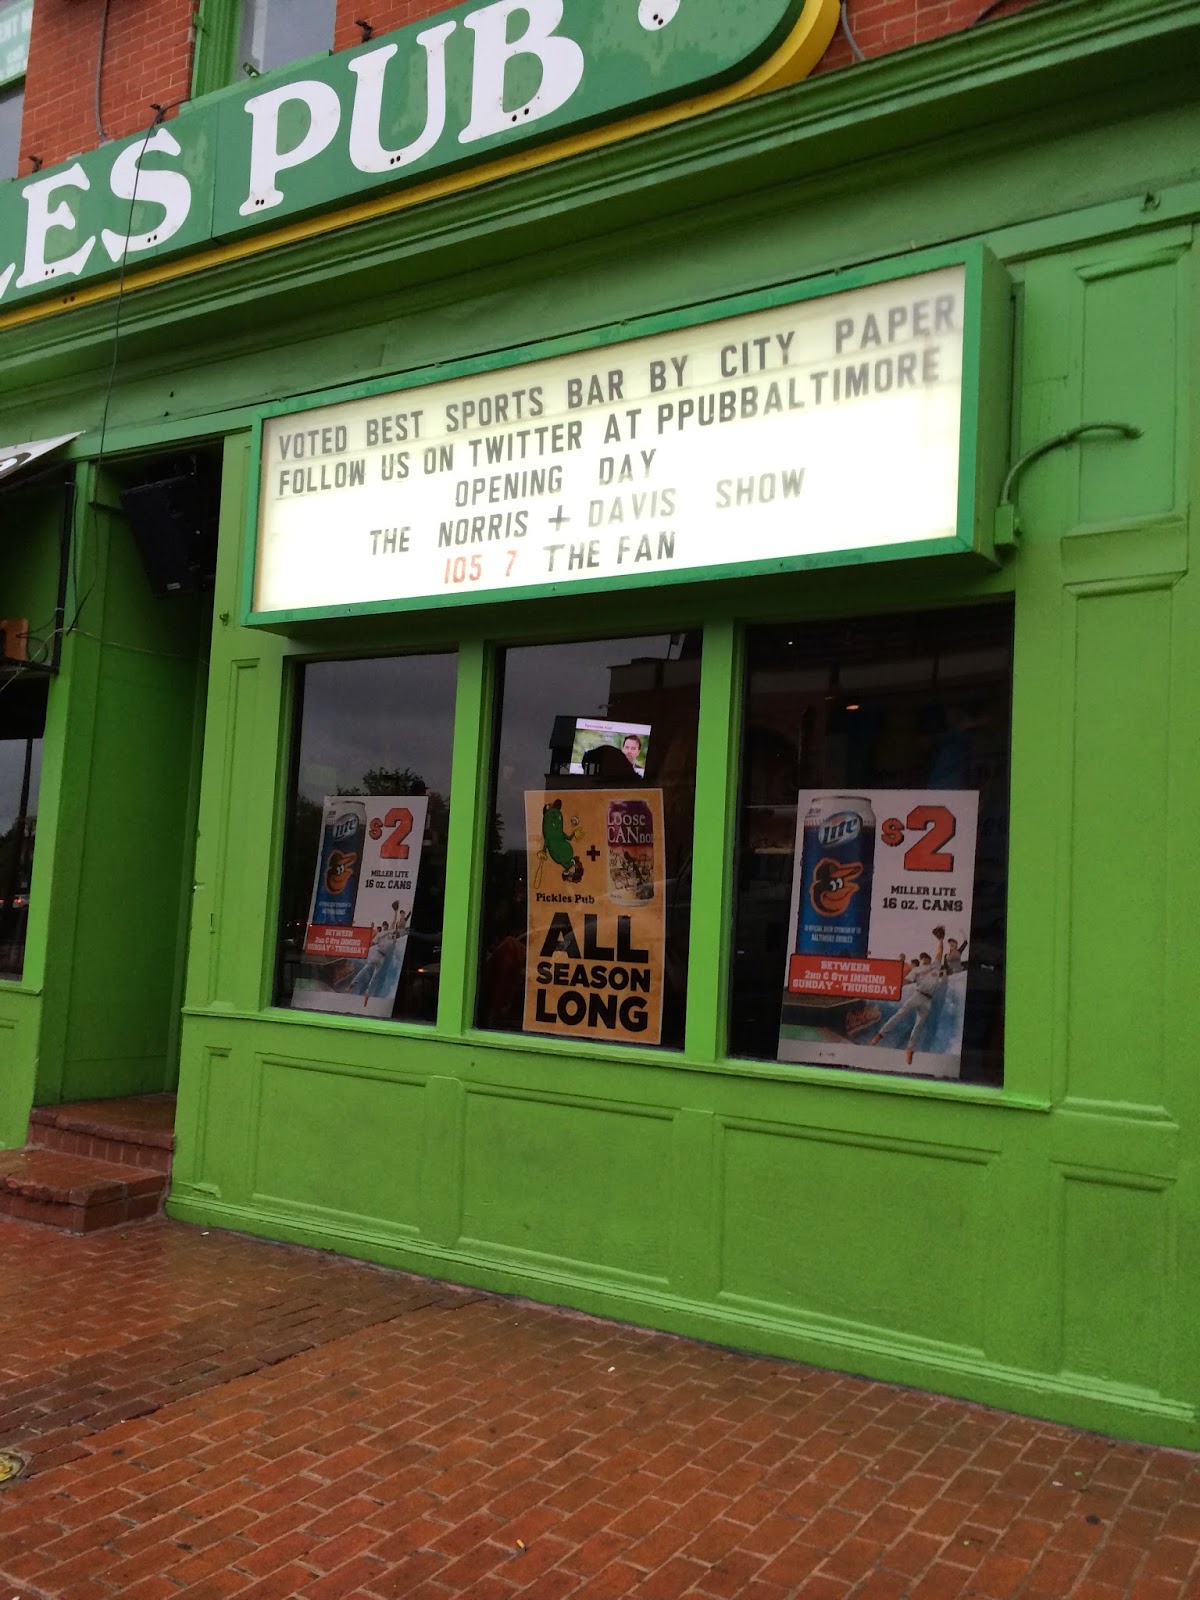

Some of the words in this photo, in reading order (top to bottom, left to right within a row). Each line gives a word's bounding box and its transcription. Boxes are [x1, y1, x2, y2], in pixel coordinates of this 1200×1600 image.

[0, 127, 192, 299] ES
[239, 0, 585, 216] PUB
[279, 425, 347, 460] VOTED
[366, 410, 423, 446] BEST
[446, 387, 543, 432] SPORTS
[567, 369, 624, 409] BAR
[650, 355, 688, 393] BY
[720, 331, 795, 378] CITY
[835, 295, 955, 354] PAPER
[279, 459, 366, 495] FOLLOW
[381, 452, 410, 481] US
[423, 444, 454, 475] ON
[469, 420, 583, 467] TWITTER
[604, 408, 642, 444] AT
[657, 347, 941, 435] PPUBBALTIMORE
[455, 465, 563, 508] OPENING
[598, 448, 657, 486] DAY
[370, 526, 412, 555] THE
[438, 510, 529, 548] NORRIS
[587, 488, 676, 528] DAVIS
[715, 467, 806, 509] SHOW
[444, 554, 483, 584] 105
[504, 550, 518, 577] 7
[543, 539, 601, 572] THE
[617, 531, 675, 564] FAN
[369, 807, 414, 859] $2
[607, 808, 646, 826] Loose
[822, 818, 858, 845] Lite
[881, 805, 957, 873] $2
[365, 879, 374, 888] 16
[387, 880, 412, 890] CANS
[371, 869, 394, 878] MILLER
[395, 870, 410, 878] LITE
[890, 885, 930, 896] MILLER
[932, 886, 957, 897] LITE
[536, 892, 573, 903] Pickles
[574, 894, 596, 904] Pub
[882, 897, 898, 909] 16
[922, 899, 964, 912] CANS
[539, 911, 649, 964] ALL
[536, 961, 651, 993] SEASON
[821, 961, 871, 973] BETWEEN
[792, 979, 834, 990] SUNDAY
[841, 982, 897, 995] THURSDAY
[535, 988, 649, 1032] LONG
